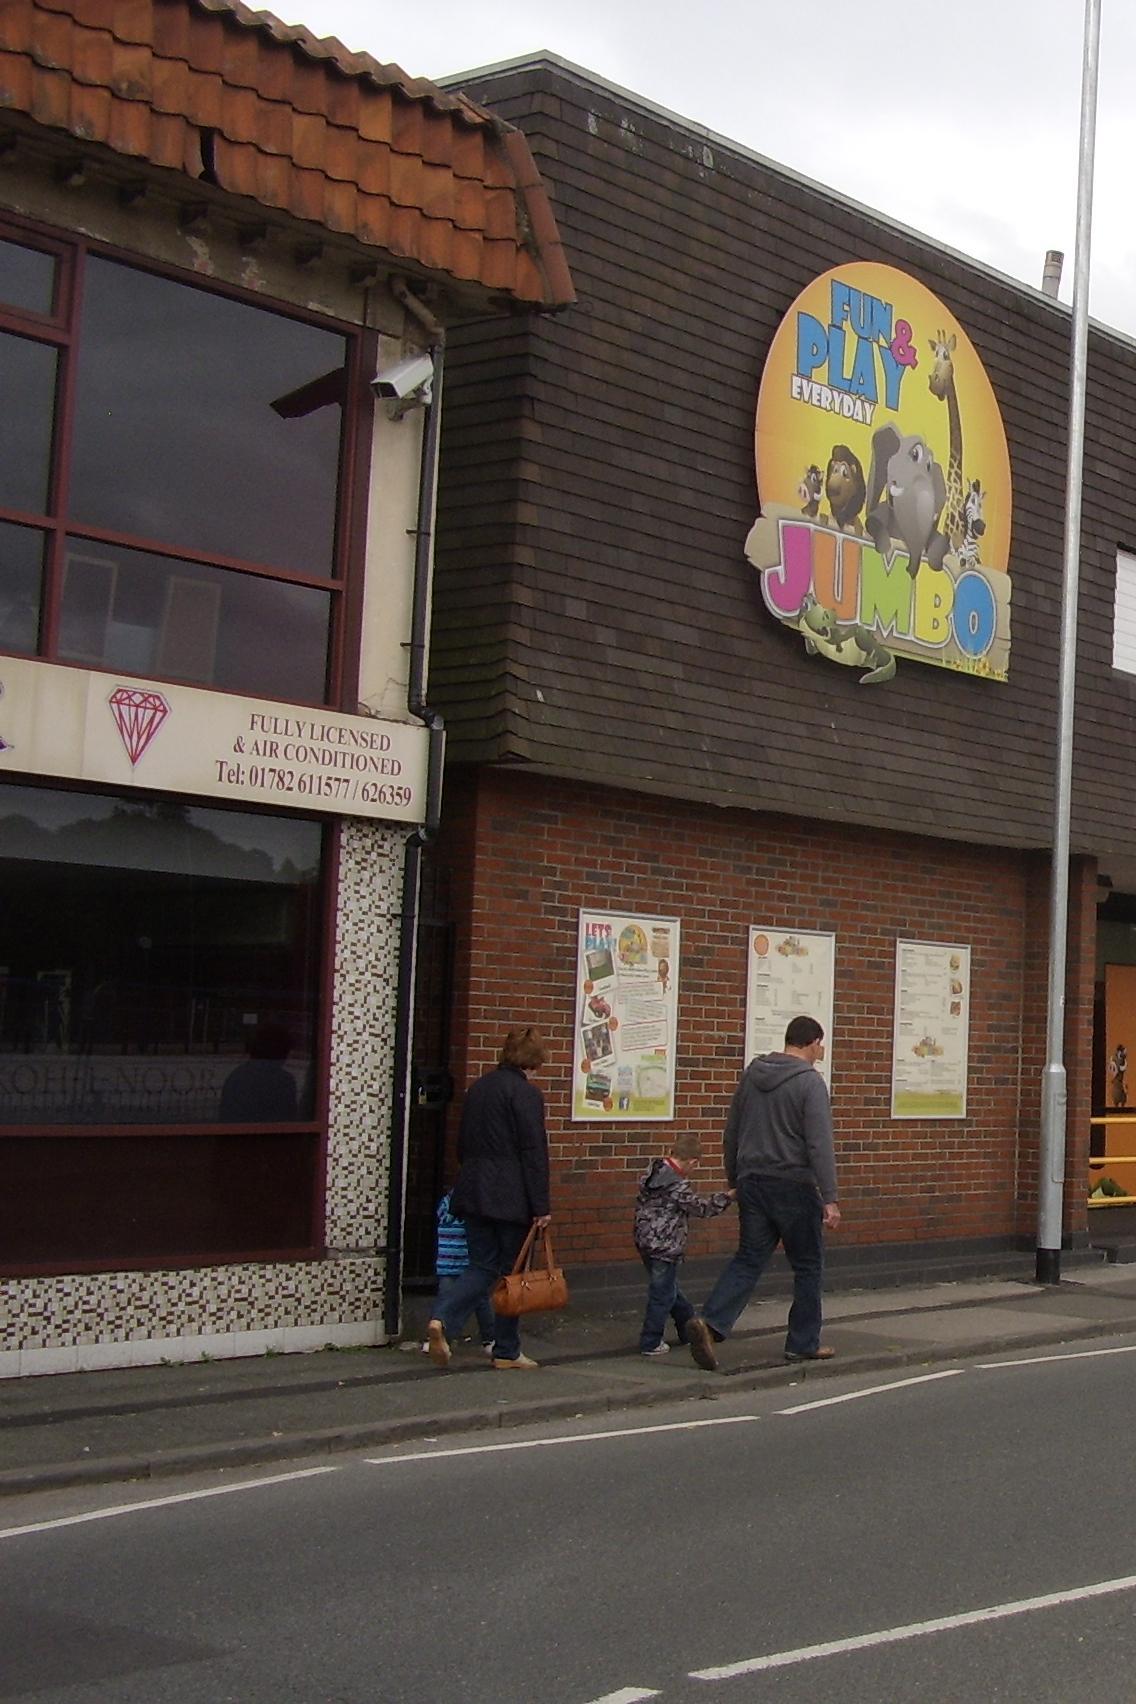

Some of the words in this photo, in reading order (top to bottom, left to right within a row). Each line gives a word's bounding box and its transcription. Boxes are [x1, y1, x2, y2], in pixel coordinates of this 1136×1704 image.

[831, 279, 893, 349] FUN
[890, 319, 918, 370] &
[797, 311, 906, 411] PLAY
[791, 373, 876, 426] EVERYDAY
[764, 521, 995, 657] JUMBO
[233, 735, 246, 754] &
[250, 739, 279, 759] AIR
[283, 743, 402, 777] CONDITIONED
[250, 713, 307, 738] FULLY
[309, 722, 391, 752] LICENSED
[215, 759, 246, 786] Tel:
[249, 764, 294, 793] 01782
[298, 772, 352, 801] 611577
[361, 781, 412, 807] 626359
